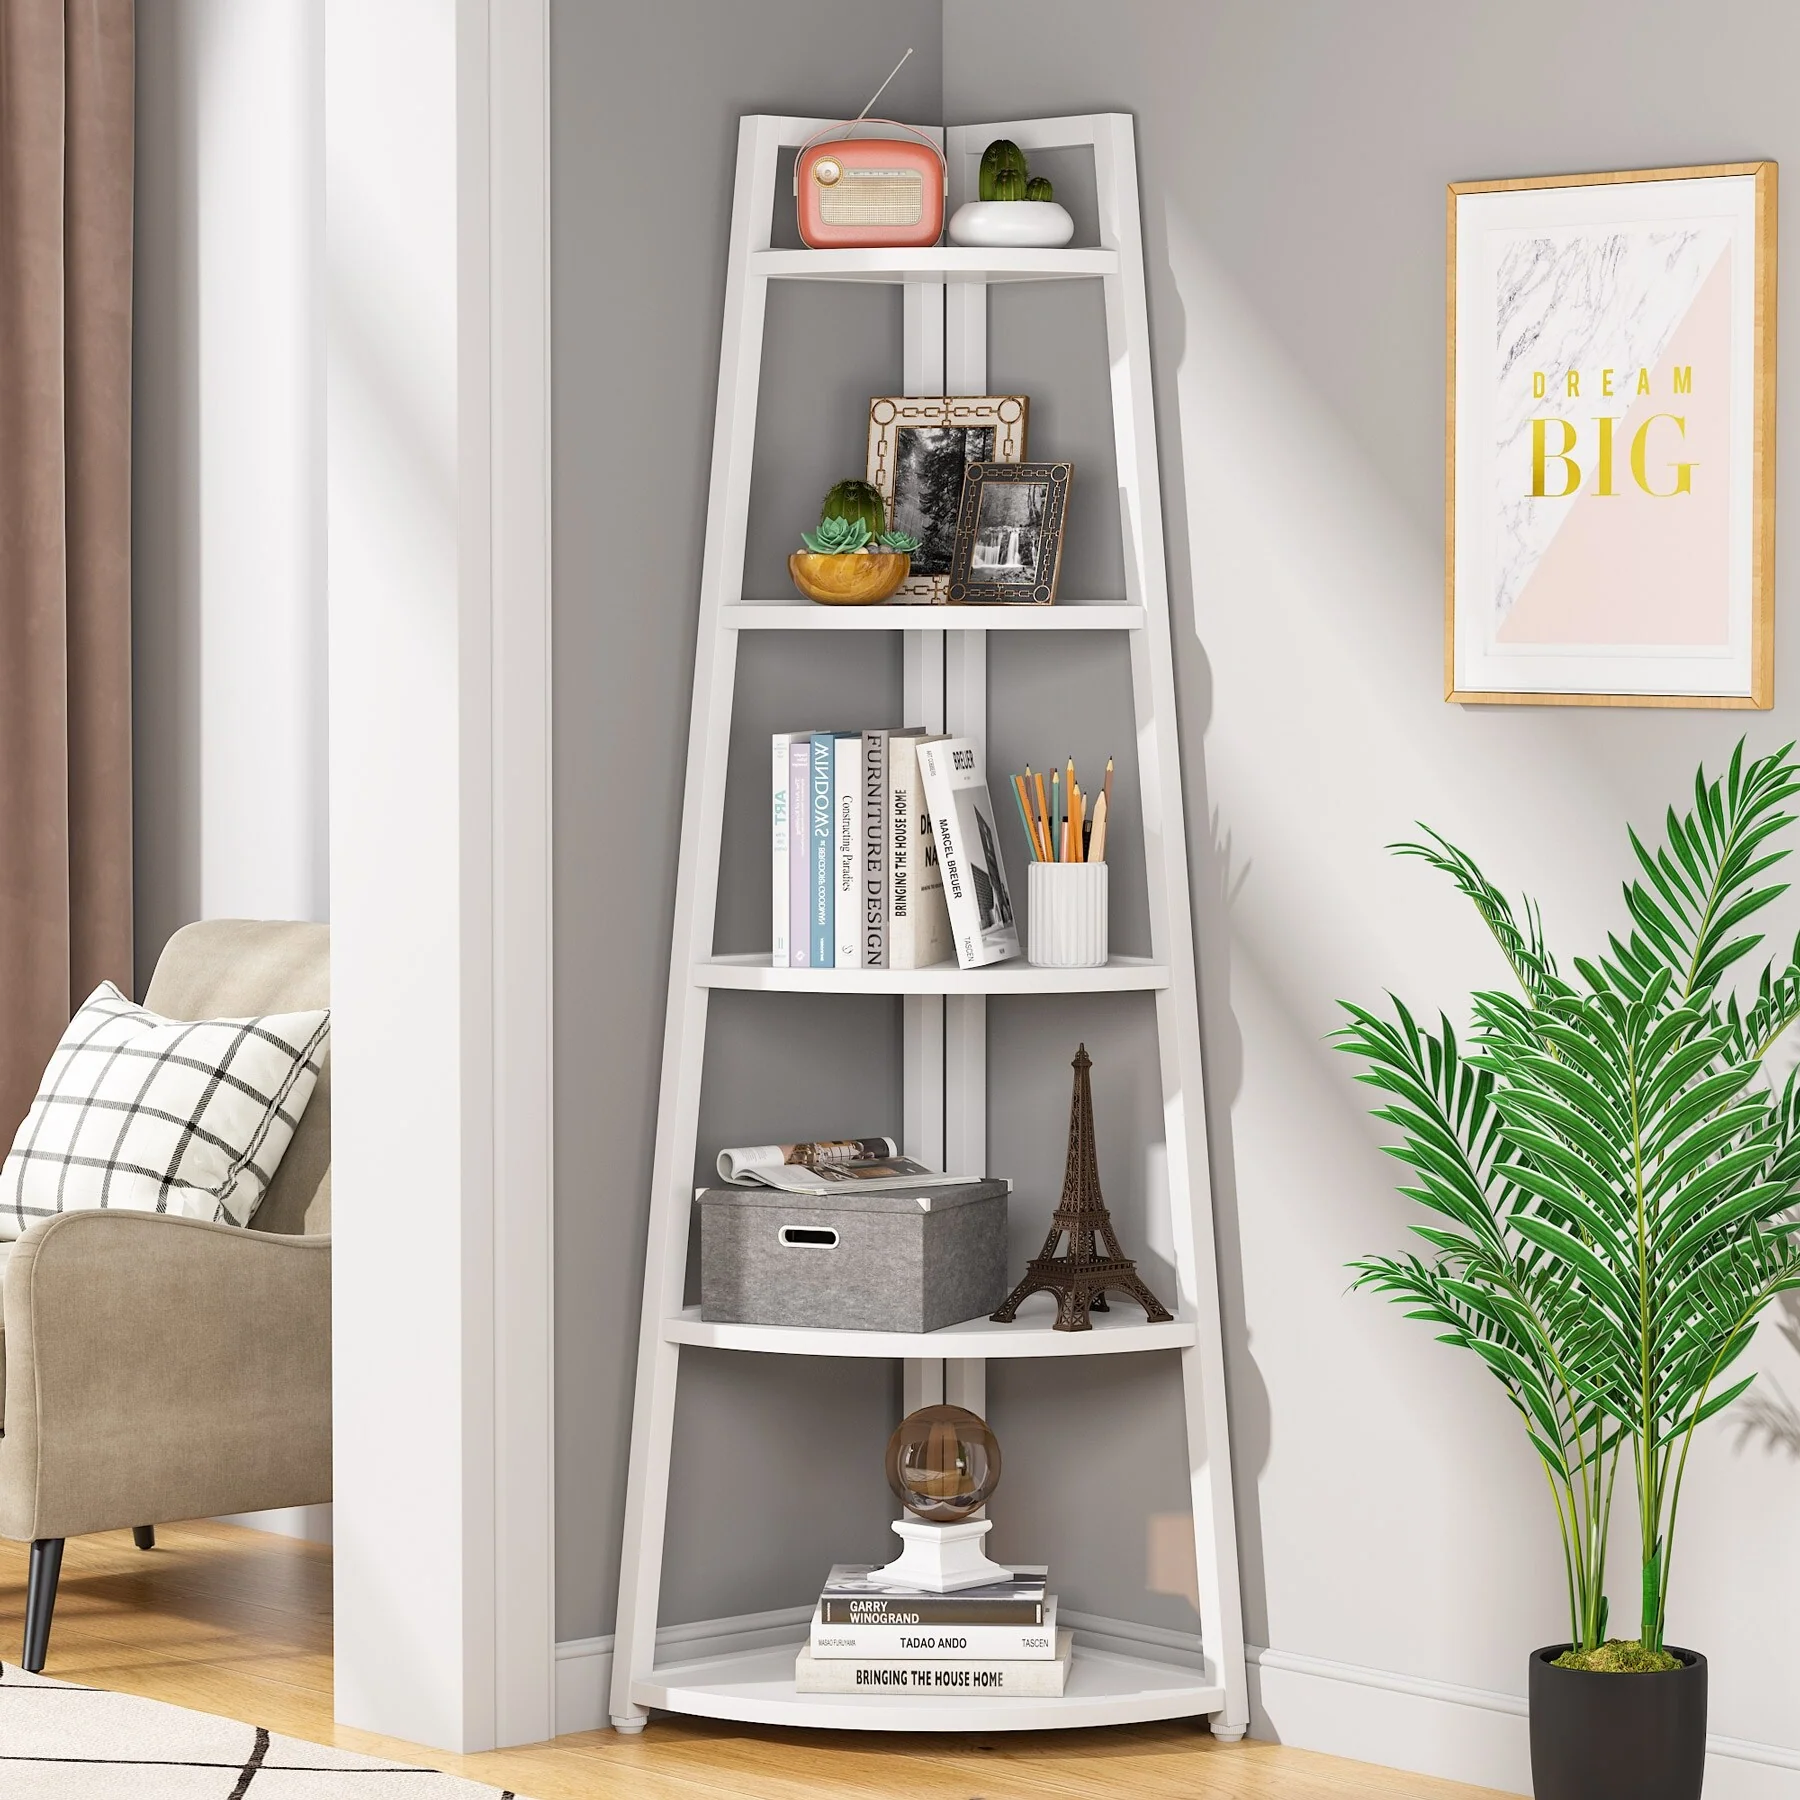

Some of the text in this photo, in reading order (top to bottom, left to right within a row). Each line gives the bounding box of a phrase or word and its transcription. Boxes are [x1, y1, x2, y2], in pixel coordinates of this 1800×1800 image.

[1533, 366, 1692, 398] DREAM
[1524, 413, 1700, 497] BIG
[840, 795, 853, 891] Constructing Paradies
[867, 735, 882, 966] FURNITURE DESIGN
[895, 789, 907, 917] BRINGING THE HOUSE HOME
[939, 818, 962, 899] MARCEL BREUER
[965, 936, 974, 962] TASCEN
[849, 1601, 888, 1612] GARRY
[849, 1613, 920, 1624] WINOGRAND
[900, 1637, 967, 1649] TADAO ANDO
[1021, 1638, 1049, 1648] TASCEN
[856, 1670, 1004, 1687] BRINGING THE HOUSE HOME
